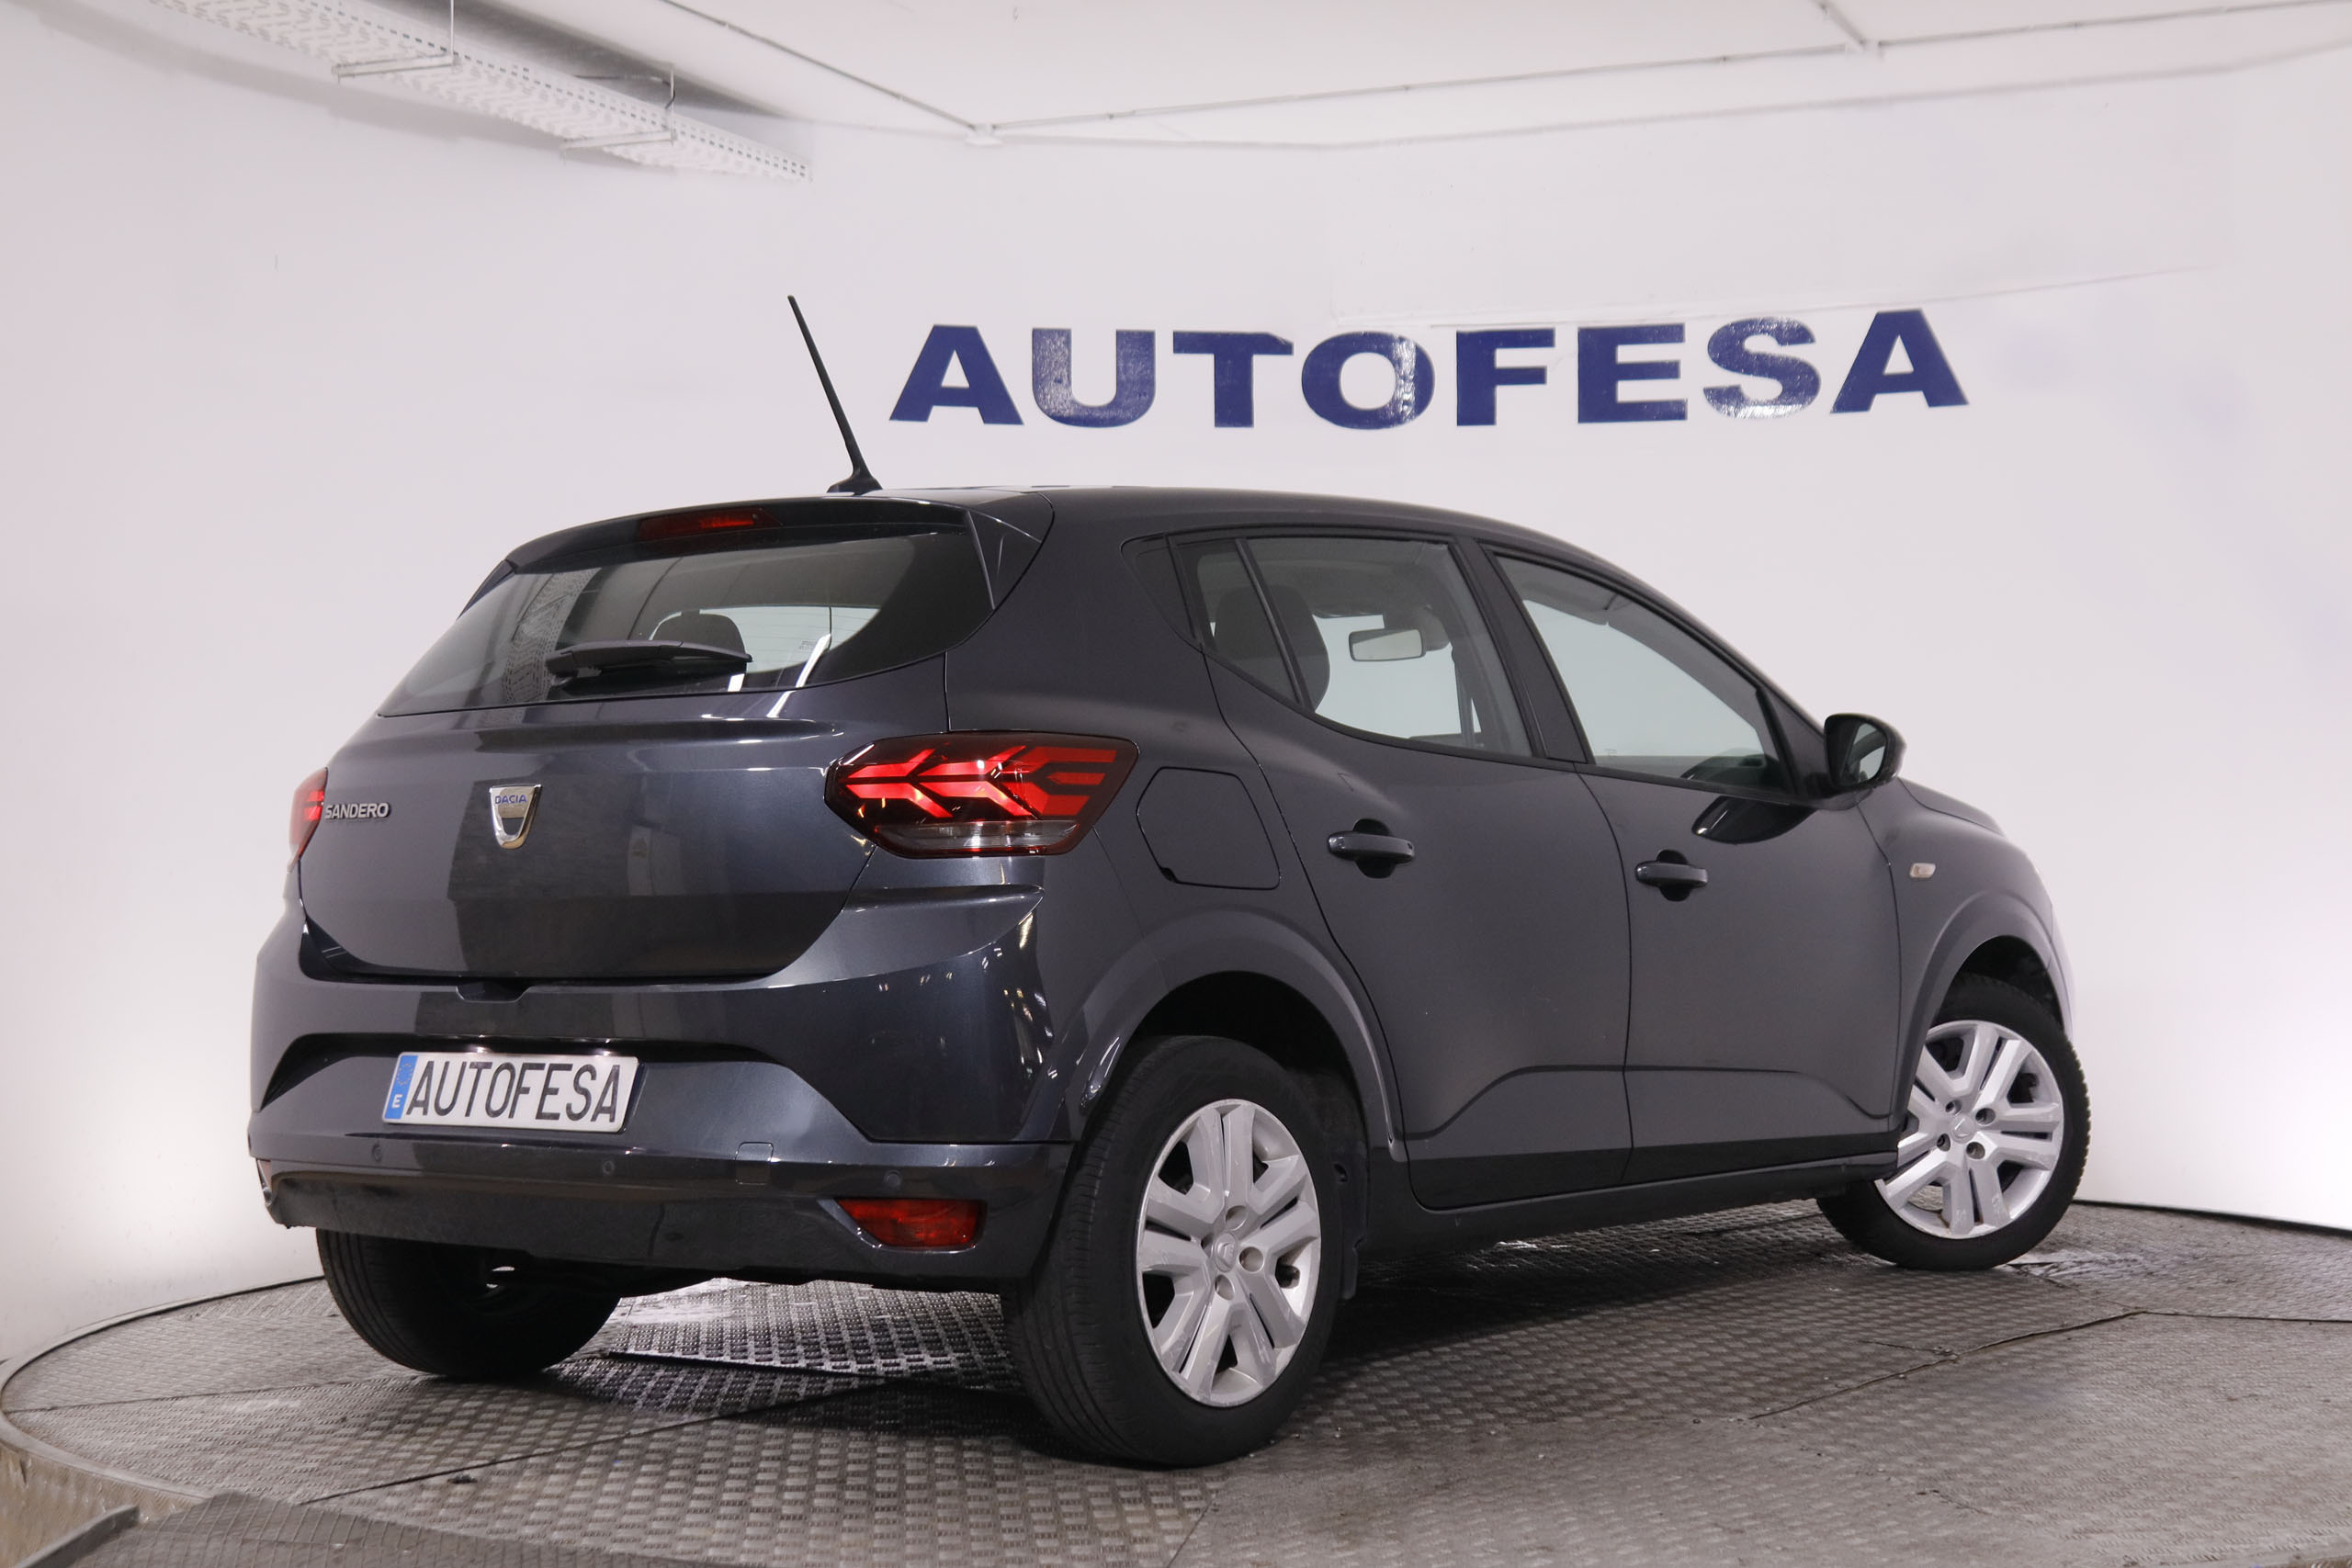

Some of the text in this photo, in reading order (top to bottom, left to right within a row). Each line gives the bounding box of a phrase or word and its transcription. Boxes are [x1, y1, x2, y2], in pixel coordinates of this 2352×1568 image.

[889, 309, 1969, 429] AUTOFESA
[323, 802, 390, 819] SANDERO
[494, 794, 527, 805] DACIA
[391, 1060, 621, 1122] E AUTOFESA
